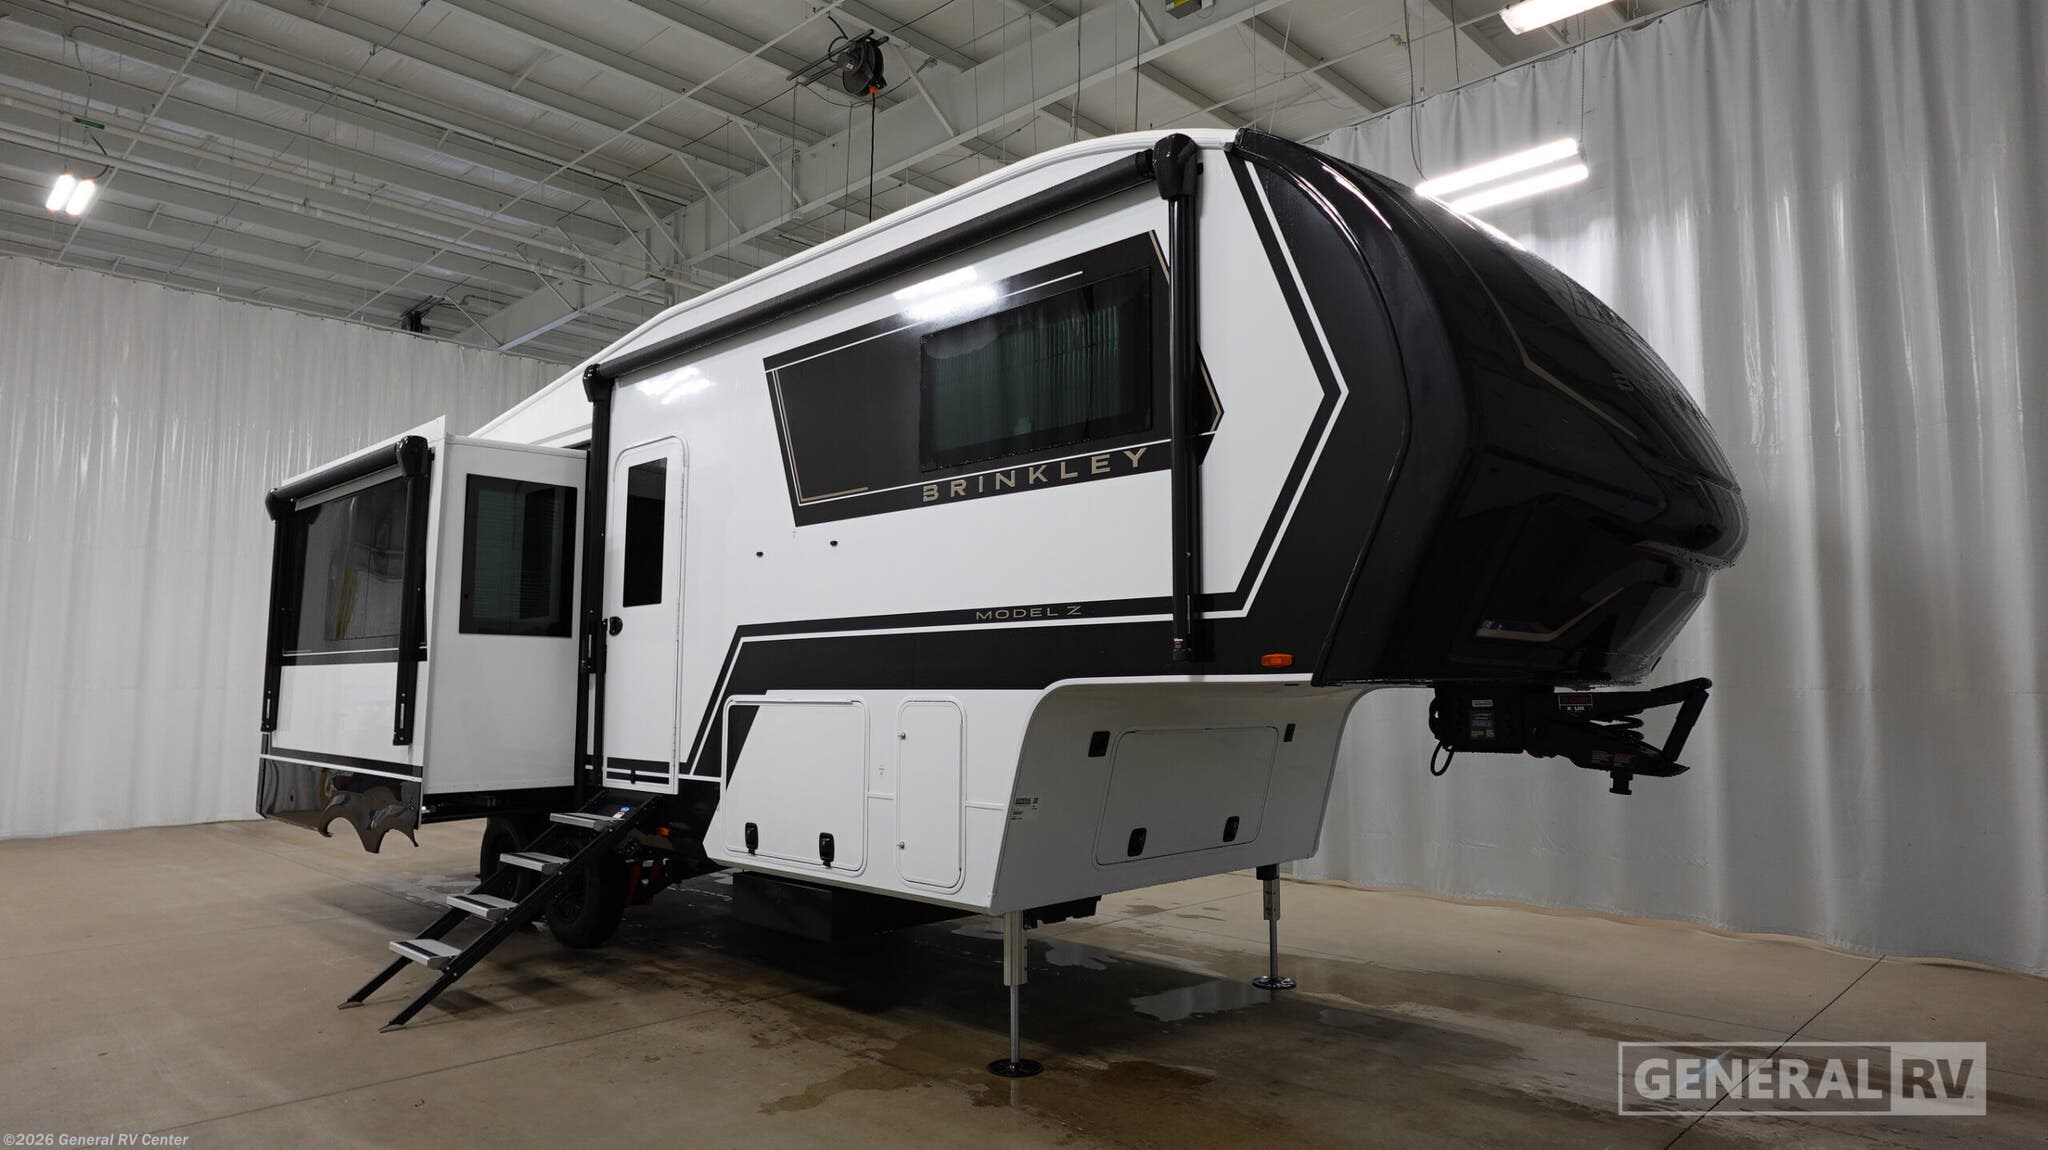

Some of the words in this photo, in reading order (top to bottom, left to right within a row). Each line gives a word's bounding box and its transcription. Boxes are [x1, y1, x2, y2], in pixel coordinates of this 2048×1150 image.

[922, 447, 1148, 502] BRINKLEY
[976, 607, 1059, 620] MODEL
[1066, 605, 1082, 616] Z
